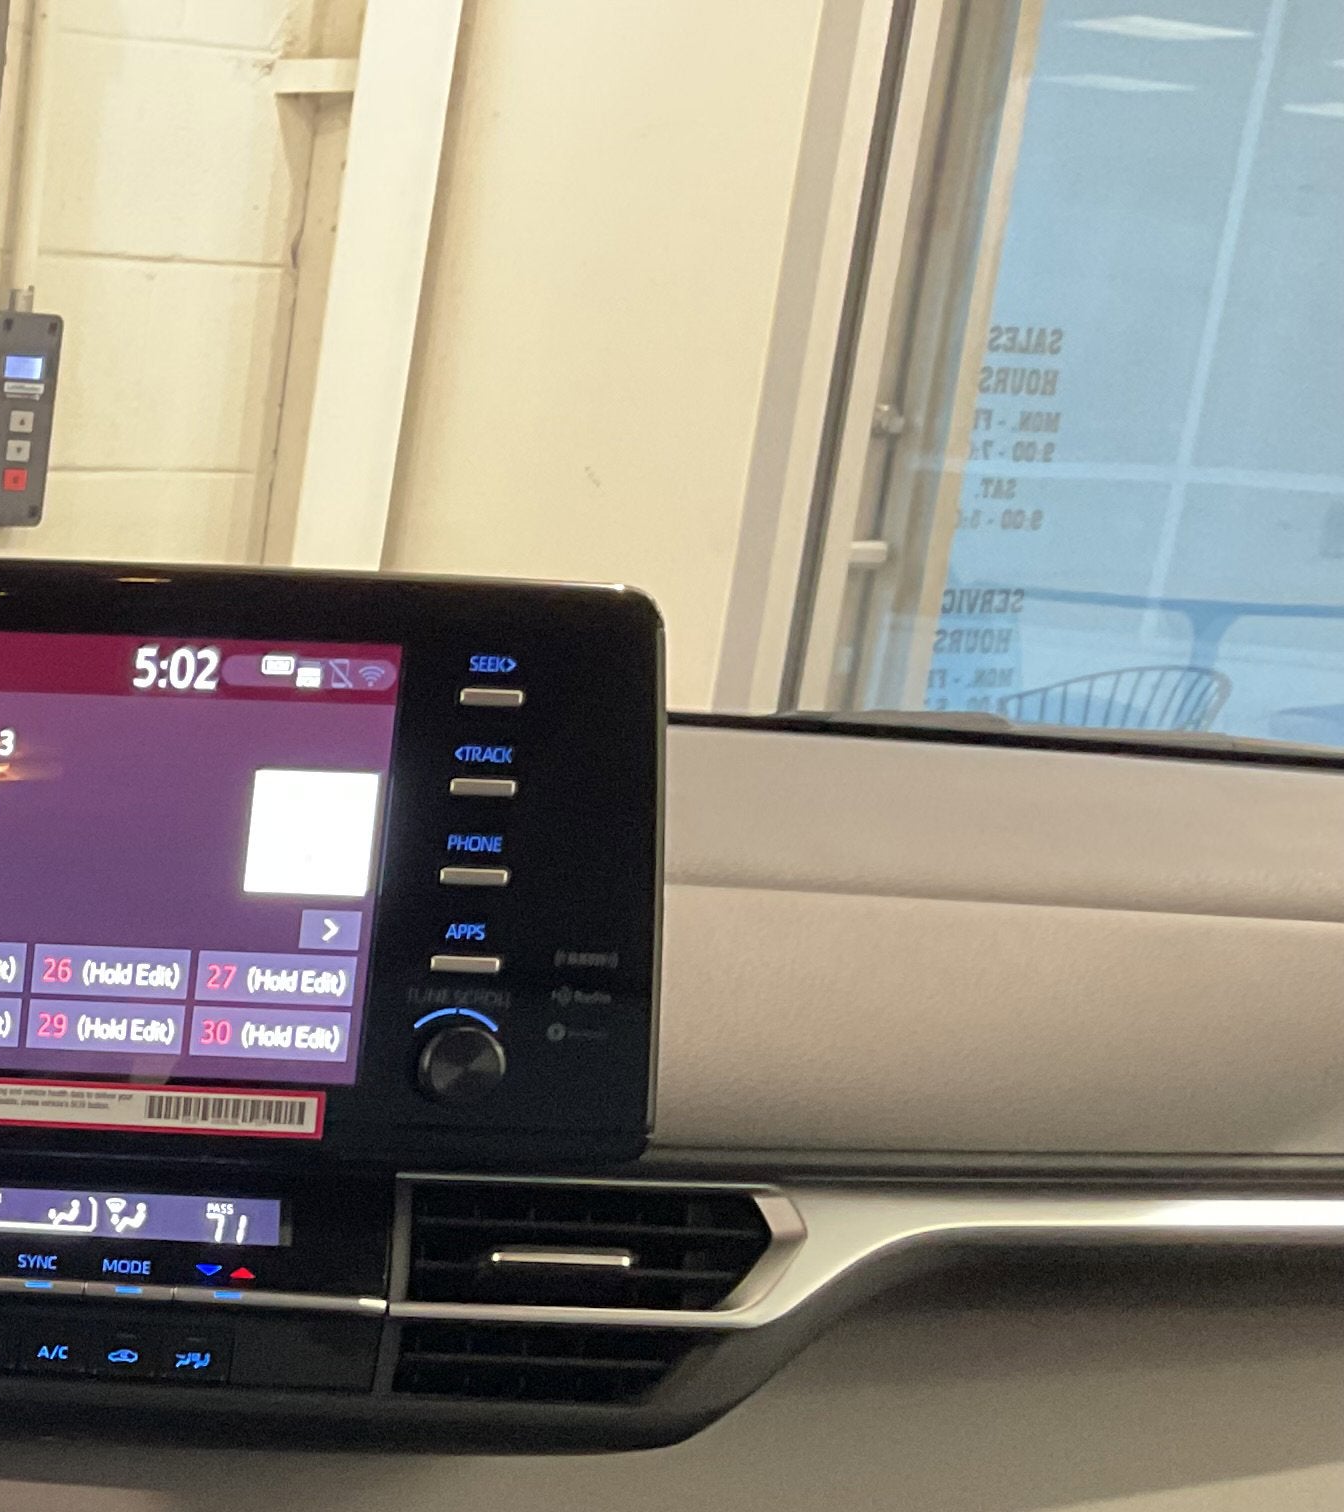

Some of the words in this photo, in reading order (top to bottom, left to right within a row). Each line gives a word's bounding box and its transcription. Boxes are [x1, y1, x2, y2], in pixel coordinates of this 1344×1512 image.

[132, 645, 220, 693] 5:02
[446, 834, 503, 854] PHONE
[445, 923, 485, 941] APPS
[42, 957, 73, 984] 26
[81, 960, 131, 987] (Hold
[134, 962, 180, 990] Edit)
[206, 965, 238, 990] 27
[246, 967, 297, 994] (Hold
[300, 969, 347, 997] Edit)
[36, 1012, 69, 1038] 29
[77, 1015, 126, 1042] (Hold
[130, 1017, 175, 1046] Edit)
[200, 1019, 231, 1045] 30
[241, 1022, 290, 1049] (Hold
[293, 1024, 340, 1053] Edit)
[206, 1203, 234, 1215] PASS
[206, 1212, 247, 1245] 71
[17, 1254, 57, 1271] SYNC
[102, 1258, 151, 1275] MODE
[37, 1344, 69, 1360] A/C
